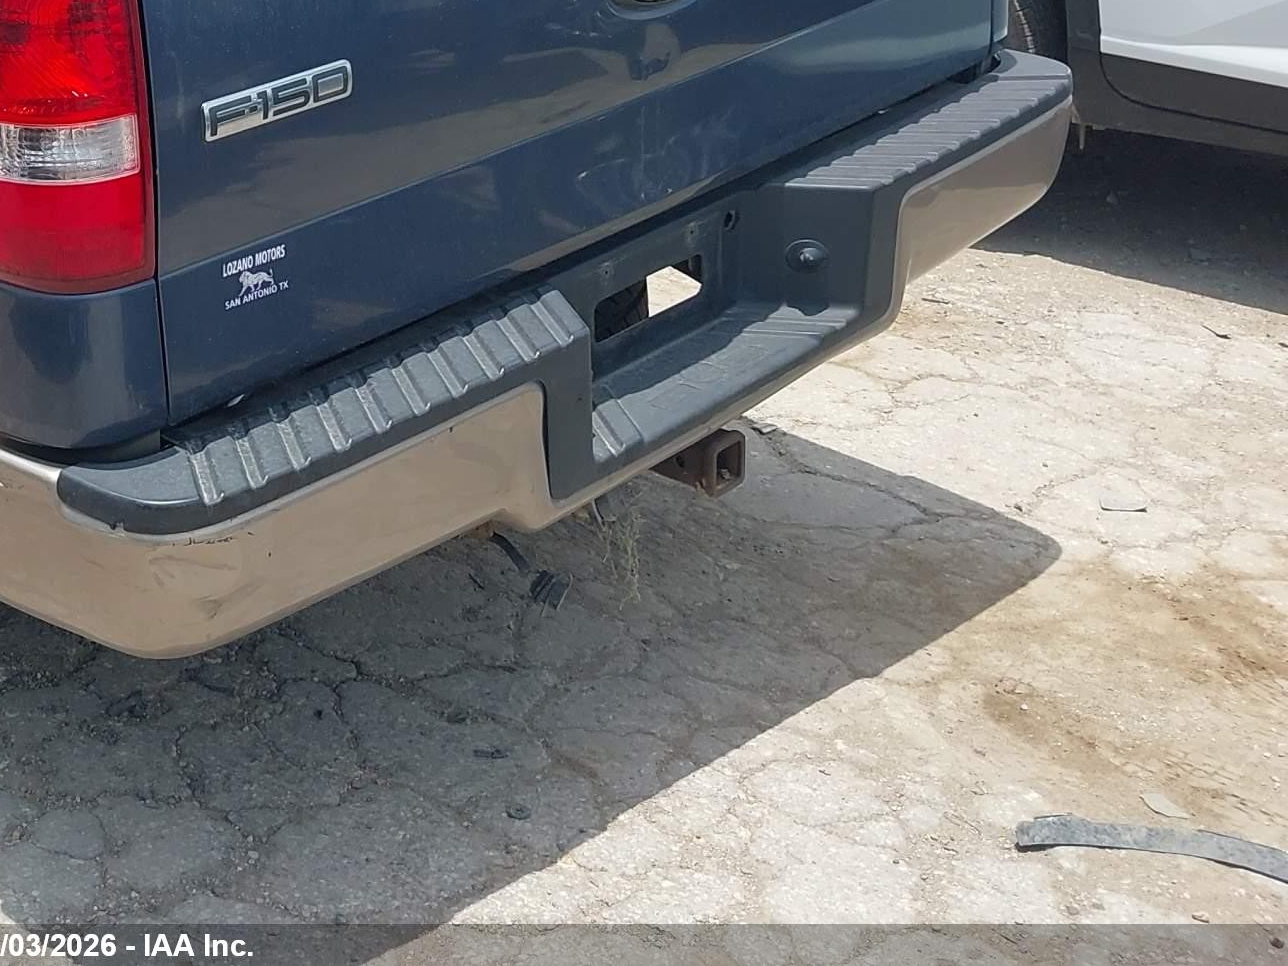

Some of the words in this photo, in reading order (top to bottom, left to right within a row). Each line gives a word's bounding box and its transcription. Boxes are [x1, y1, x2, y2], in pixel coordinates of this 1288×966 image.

[207, 64, 350, 138] F-150
[222, 255, 254, 277] LOZANO
[255, 244, 286, 266] MOTORS
[225, 297, 241, 310] SAN
[242, 284, 278, 304] ANTONIO
[279, 280, 289, 290] TX
